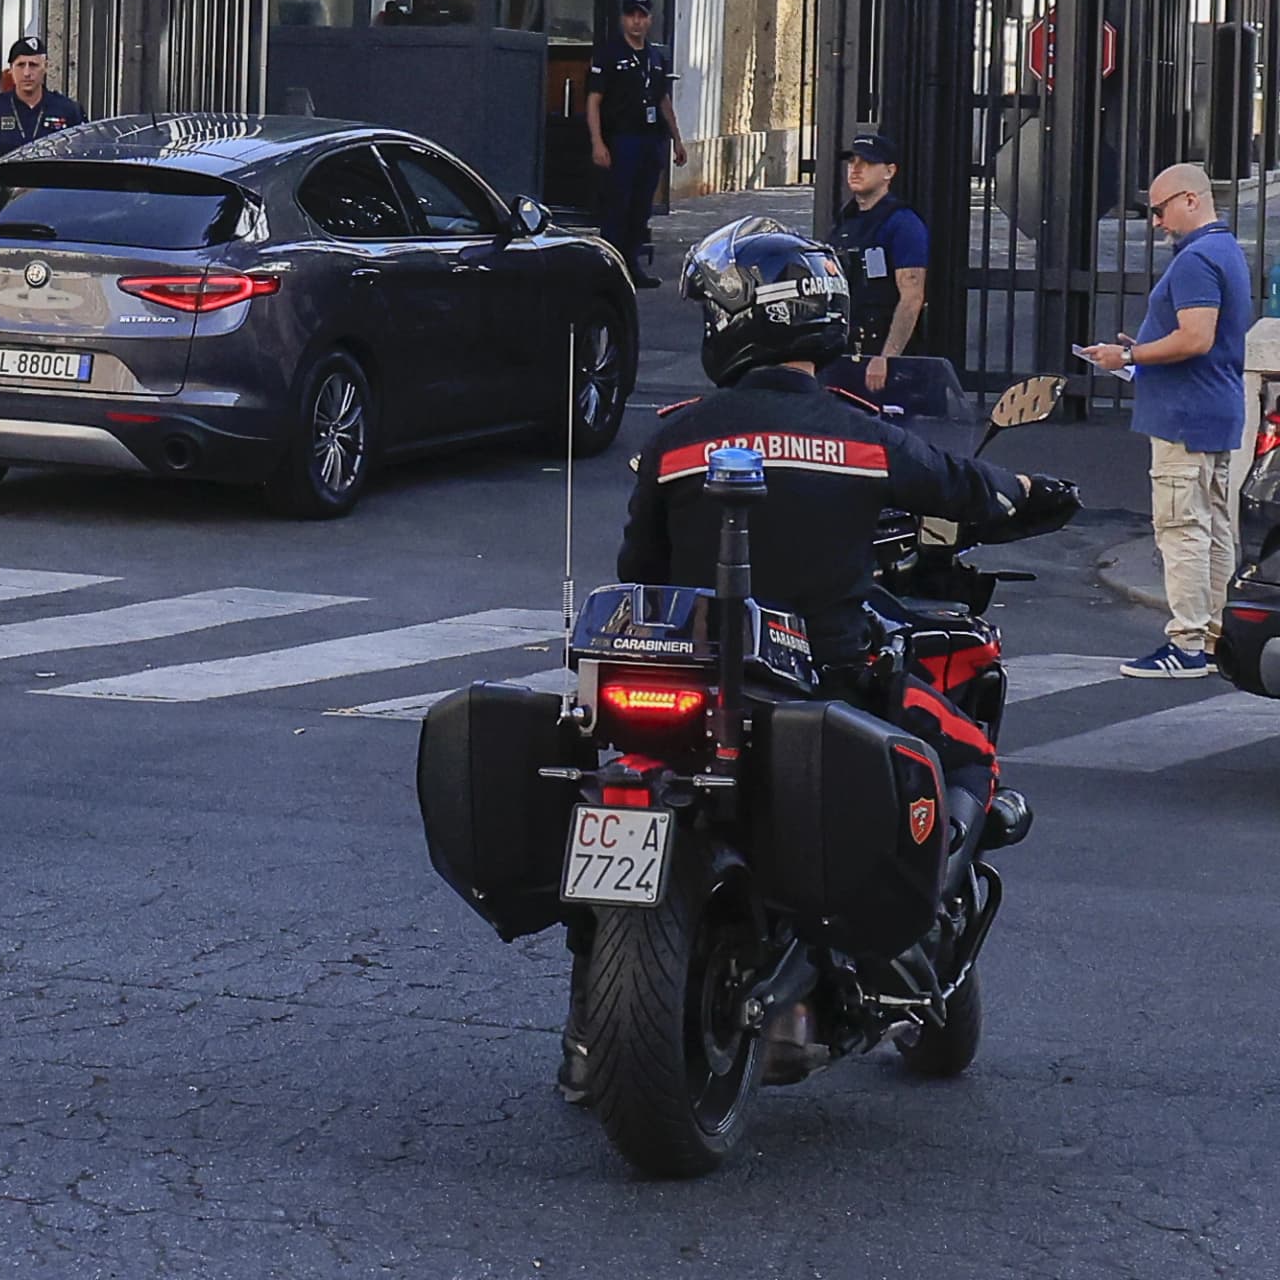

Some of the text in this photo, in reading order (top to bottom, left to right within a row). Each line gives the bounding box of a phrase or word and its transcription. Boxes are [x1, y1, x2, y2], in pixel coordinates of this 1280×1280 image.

[17, 353, 75, 377] 880CL
[612, 638, 694, 654] CARABINIERI
[578, 812, 659, 852] CC A
[572, 853, 657, 893] 7724
